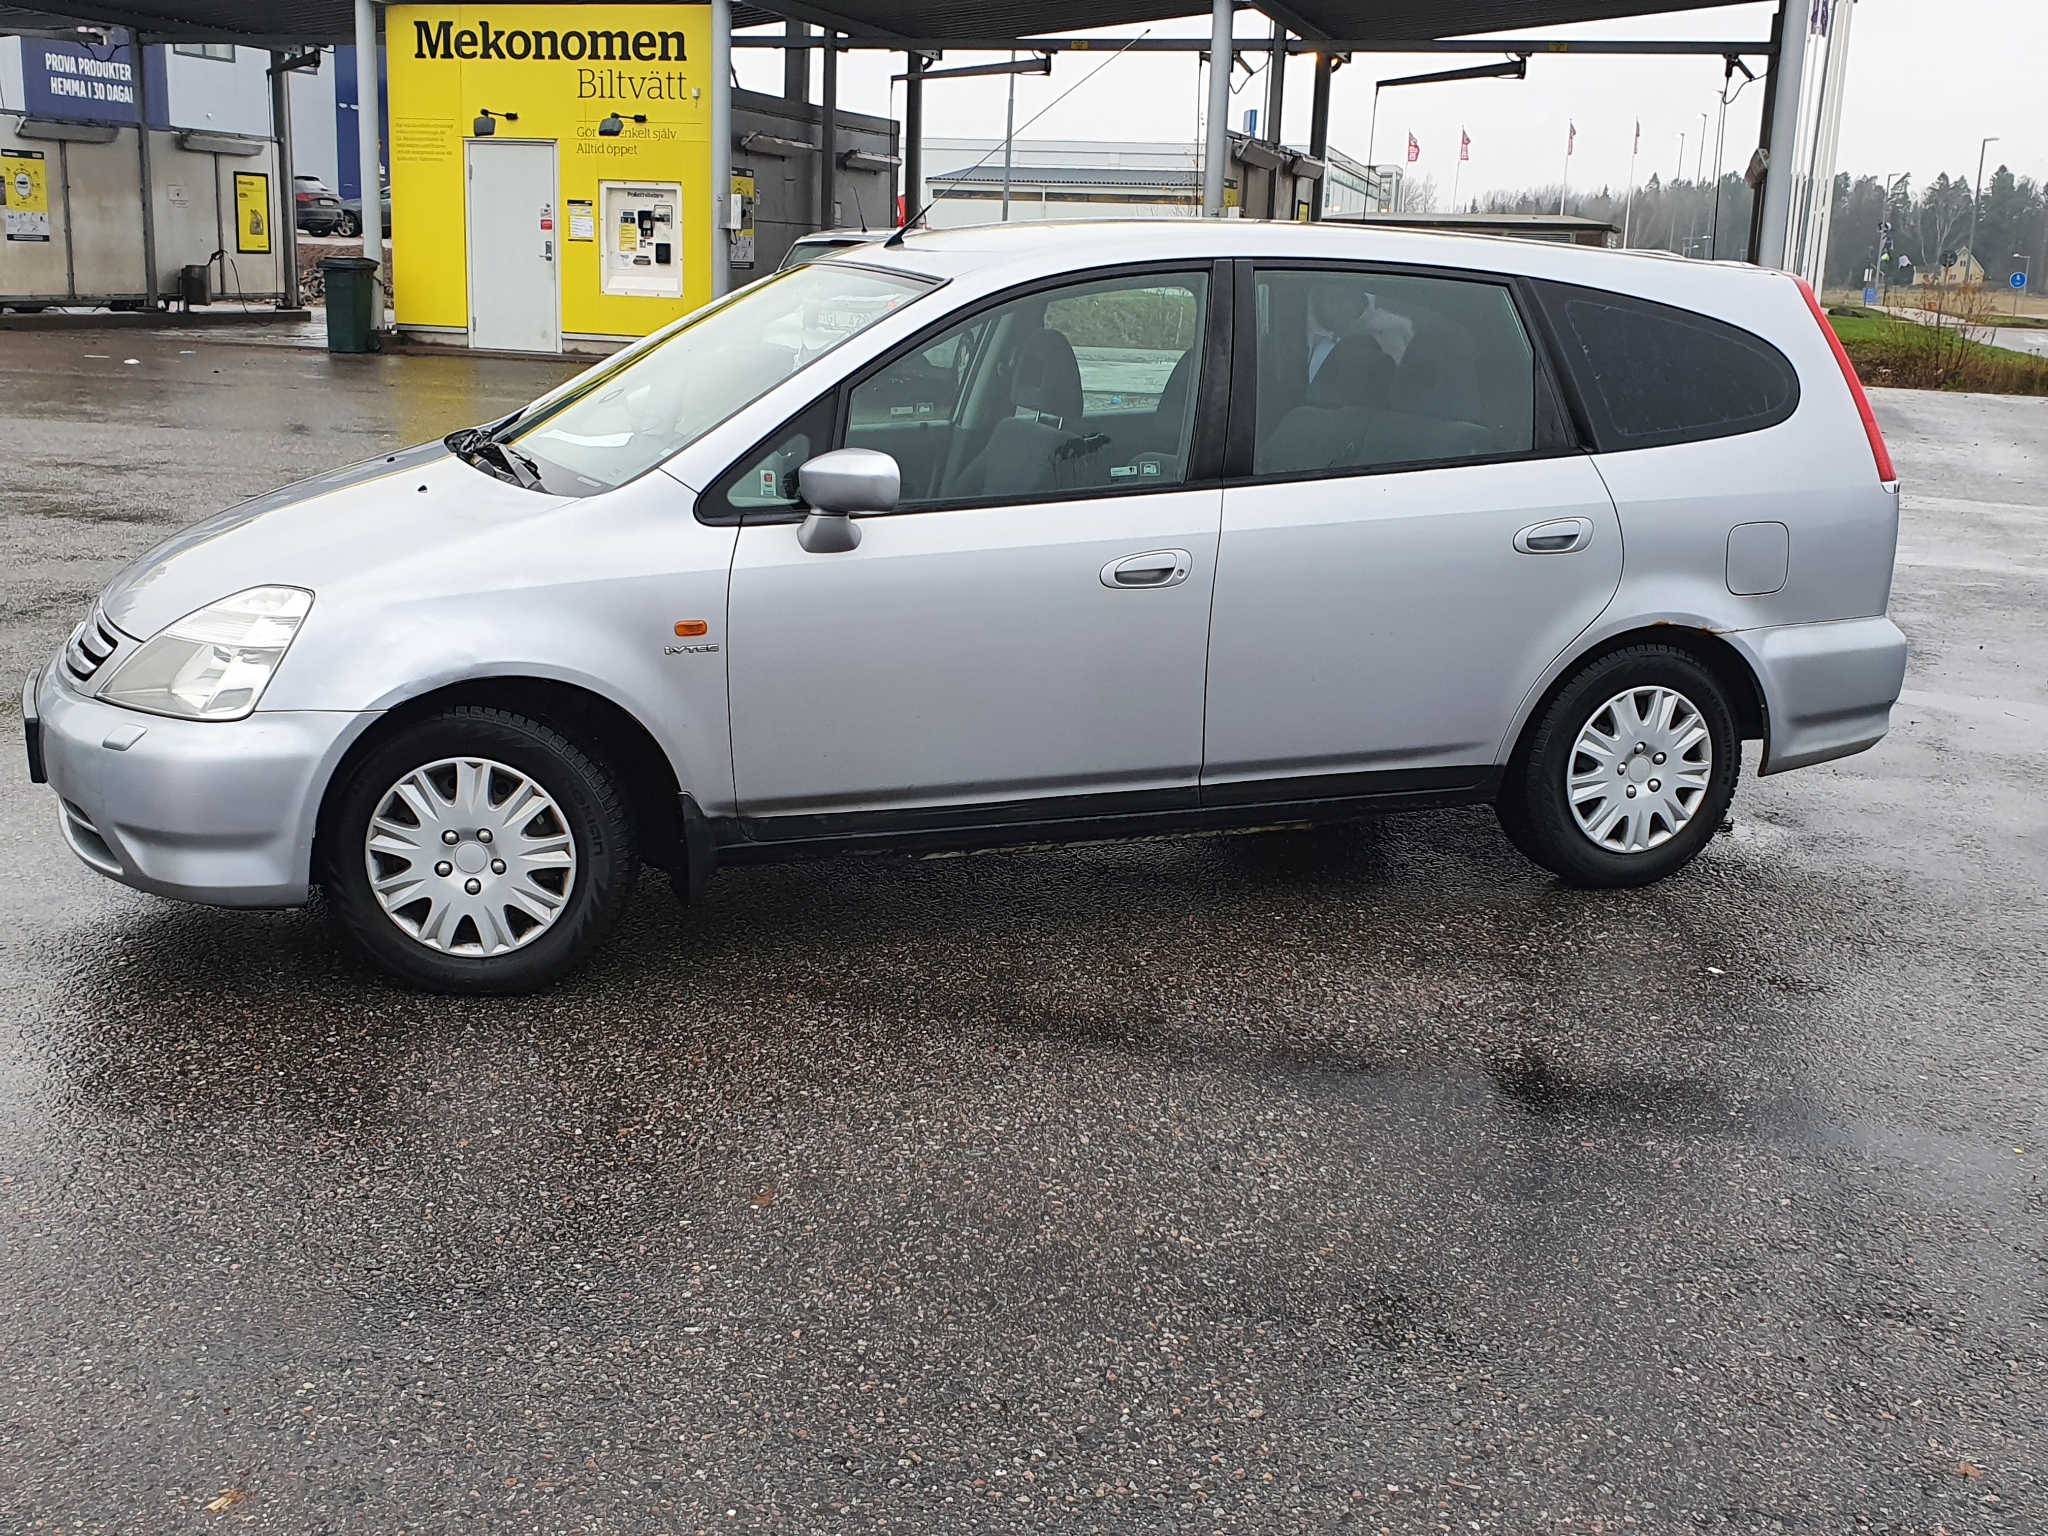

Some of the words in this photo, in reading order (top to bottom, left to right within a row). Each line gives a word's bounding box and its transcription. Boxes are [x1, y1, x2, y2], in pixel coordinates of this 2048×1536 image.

[413, 20, 688, 61] Mekonomen
[45, 52, 78, 74] PROVA
[78, 56, 132, 81] PRODUKTER
[50, 76, 88, 98] HEMMA
[93, 82, 105, 100] 30
[576, 68, 688, 100] Biltvätt
[652, 127, 678, 141] själv
[576, 143, 605, 154] Alltid
[606, 143, 638, 157] öppet
